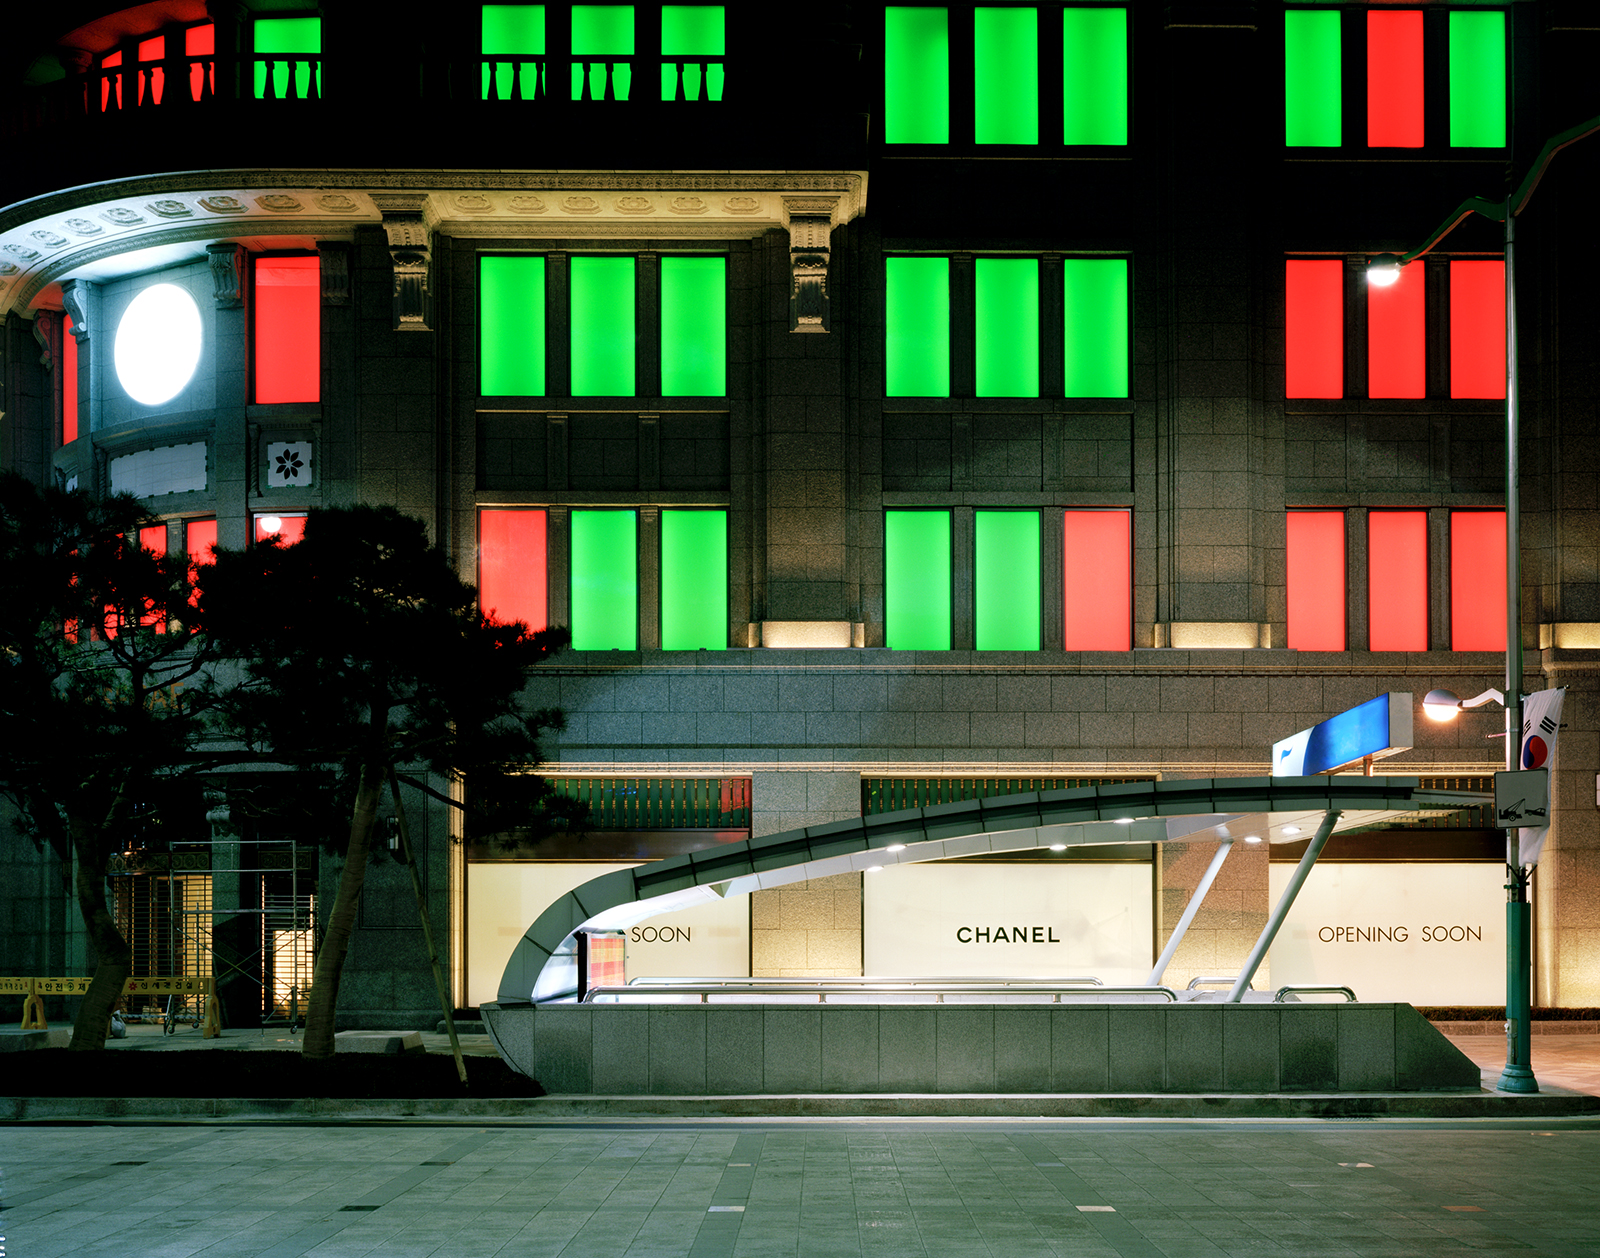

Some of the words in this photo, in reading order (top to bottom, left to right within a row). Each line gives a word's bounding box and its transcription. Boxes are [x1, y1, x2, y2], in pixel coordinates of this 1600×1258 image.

[631, 926, 691, 943] SOON
[956, 926, 1060, 943] CHANEL
[1318, 926, 1409, 943] OPENING
[1421, 925, 1482, 942] SOON
